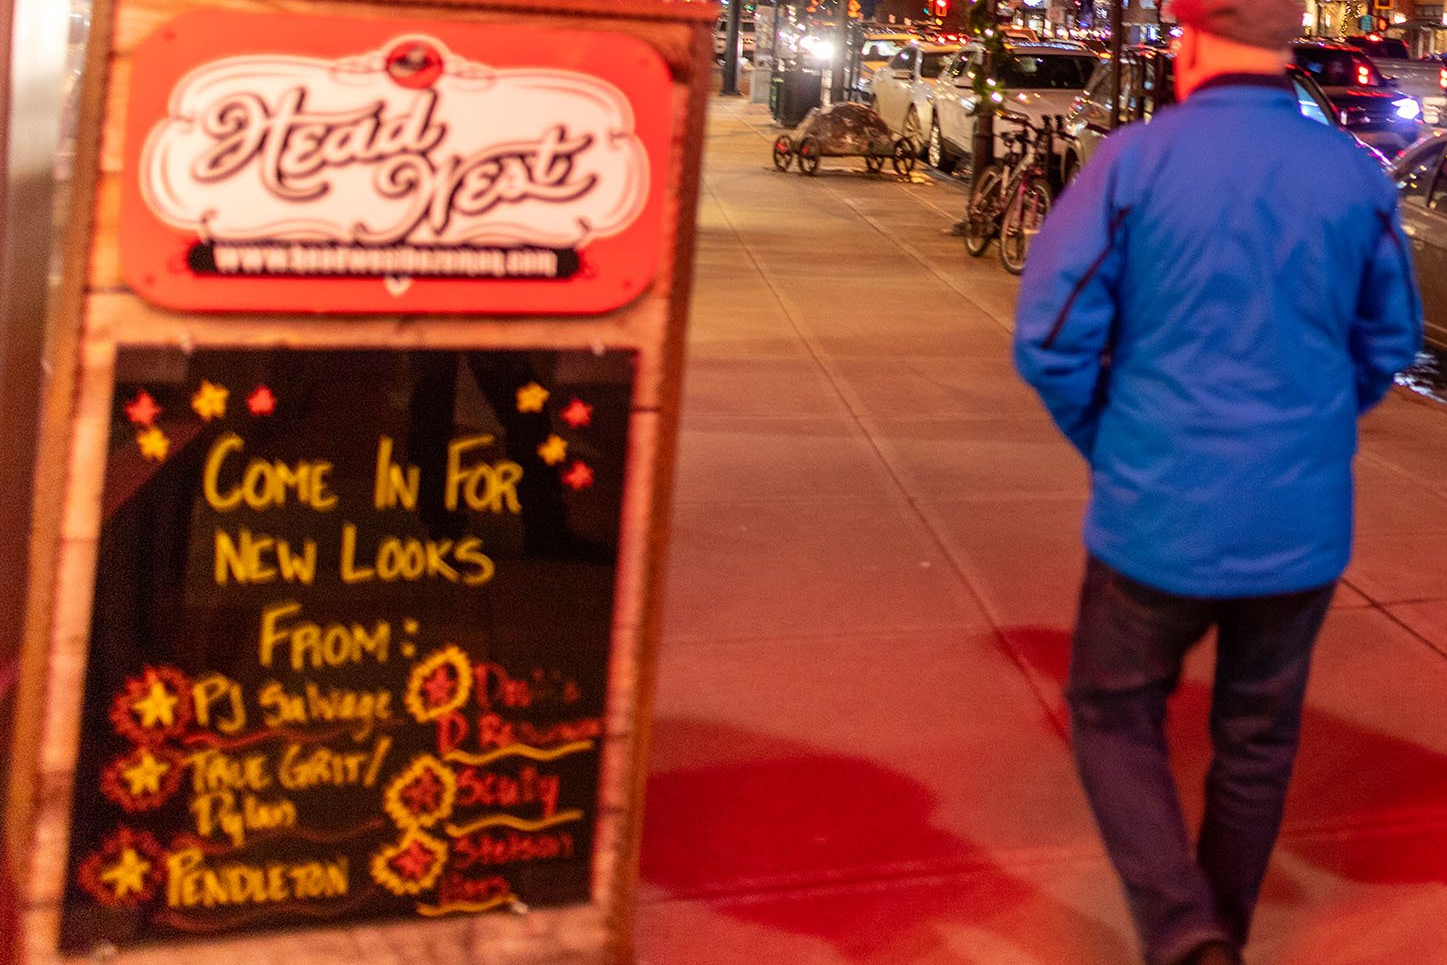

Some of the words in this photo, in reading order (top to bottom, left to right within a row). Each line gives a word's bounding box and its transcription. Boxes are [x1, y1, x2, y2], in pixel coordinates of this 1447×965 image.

[193, 85, 448, 202] Head
[354, 122, 598, 245] West
[214, 527, 319, 586] NEW
[341, 522, 496, 585] LOOKS
[192, 672, 247, 733] PJ
[168, 847, 350, 907] PENDLETON
